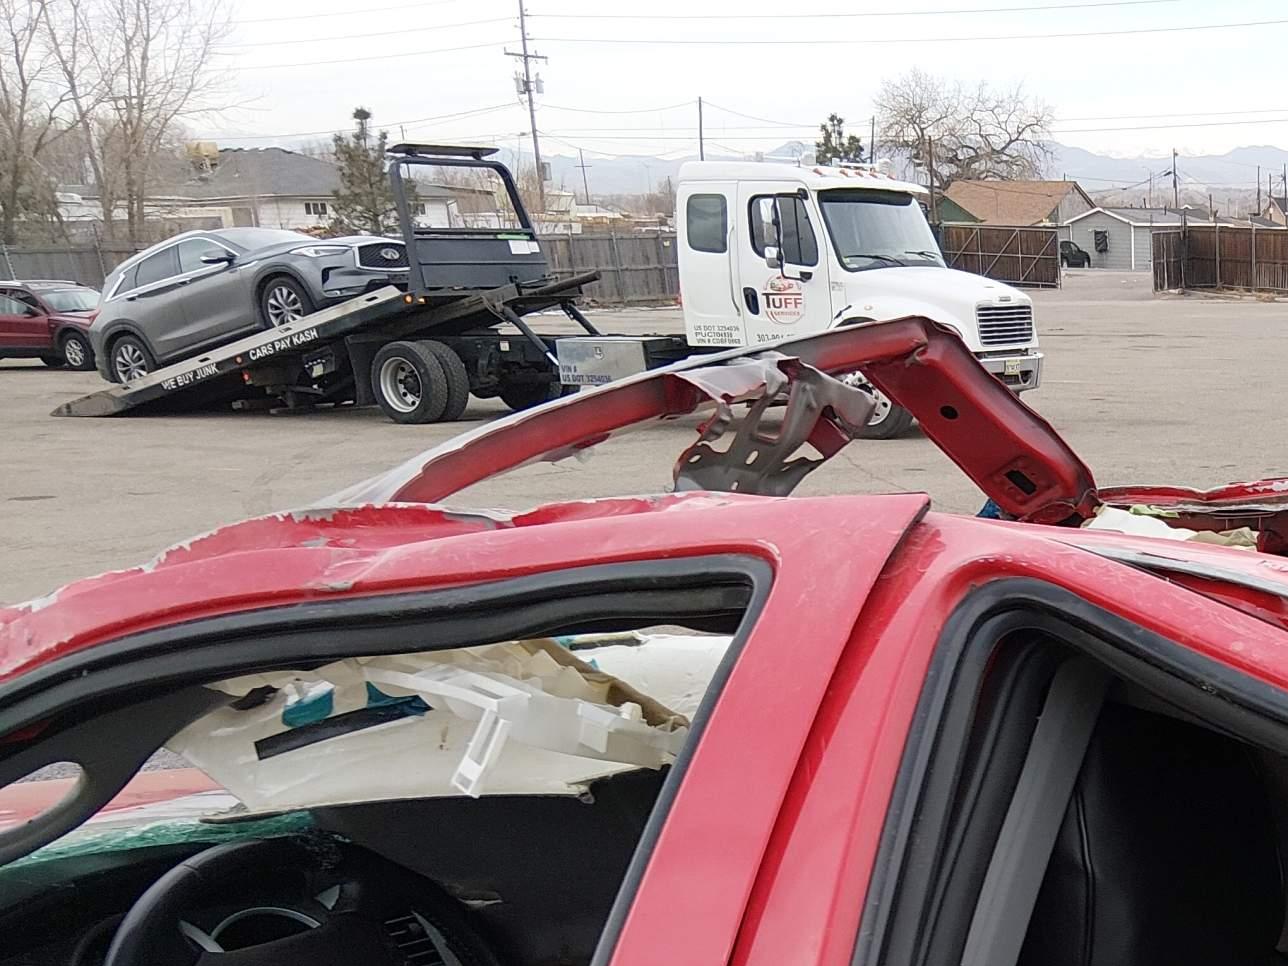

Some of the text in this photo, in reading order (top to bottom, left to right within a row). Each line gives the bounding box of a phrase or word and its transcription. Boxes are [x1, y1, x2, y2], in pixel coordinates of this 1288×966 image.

[762, 293, 802, 308] TUFF
[161, 328, 319, 390] WE BUY JUNK CARS PAY KASH
[561, 365, 572, 373] VIN
[562, 374, 571, 383] US
[572, 374, 584, 383] DOT
